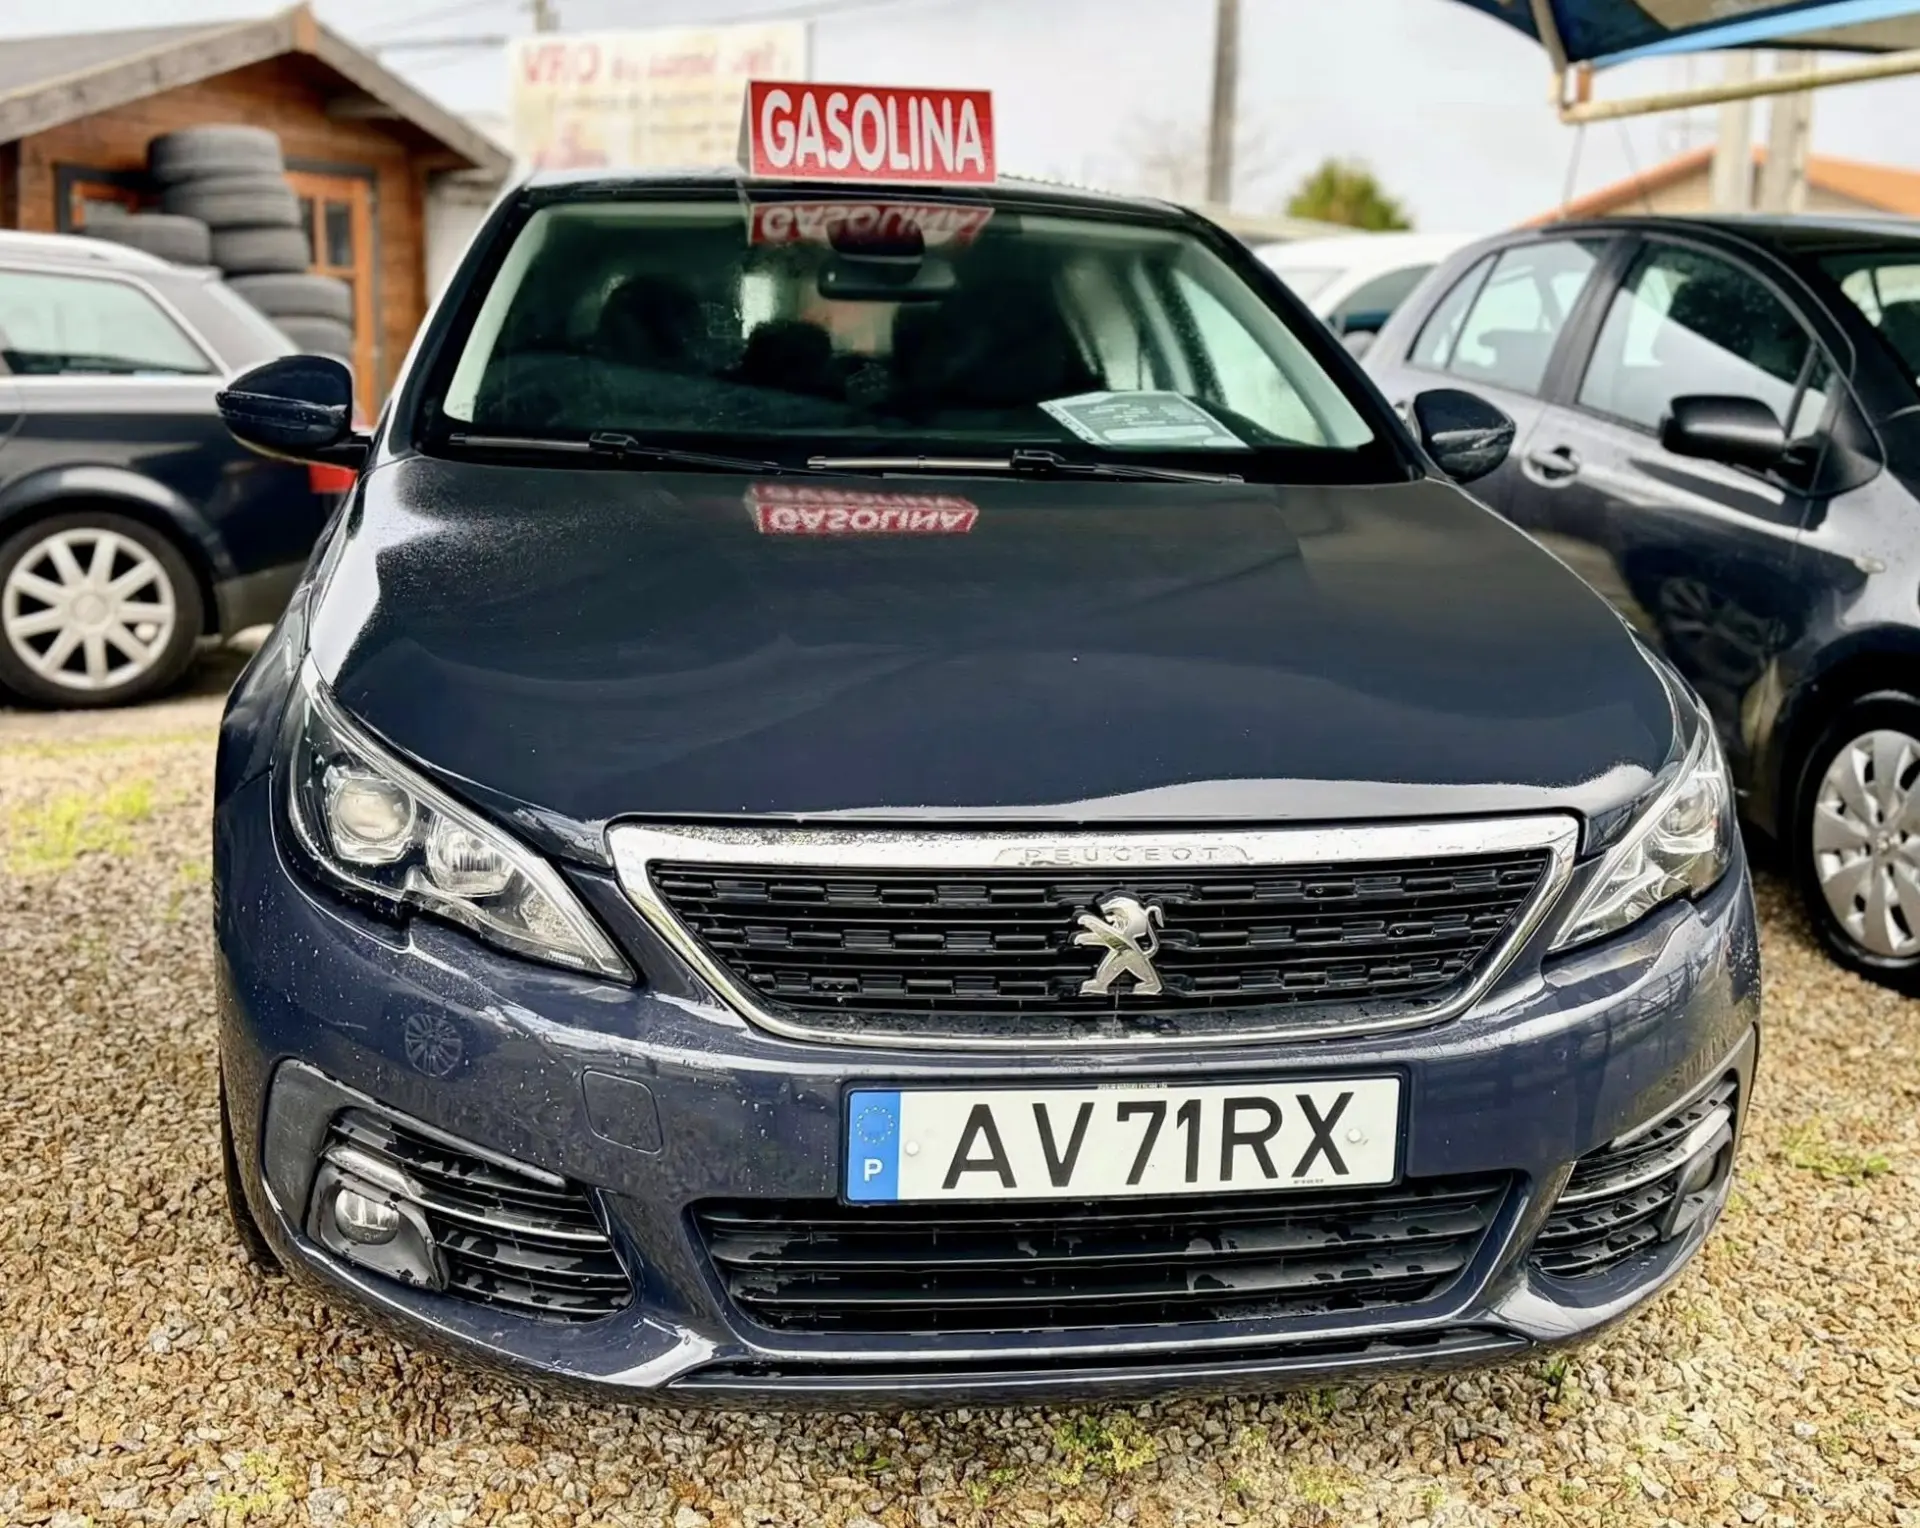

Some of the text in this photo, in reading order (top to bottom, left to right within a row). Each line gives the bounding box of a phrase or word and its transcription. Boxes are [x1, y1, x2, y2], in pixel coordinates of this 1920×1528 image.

[761, 89, 986, 175] GASOLINA
[1025, 847, 1219, 862] PEUGEOT
[863, 1159, 884, 1183] P
